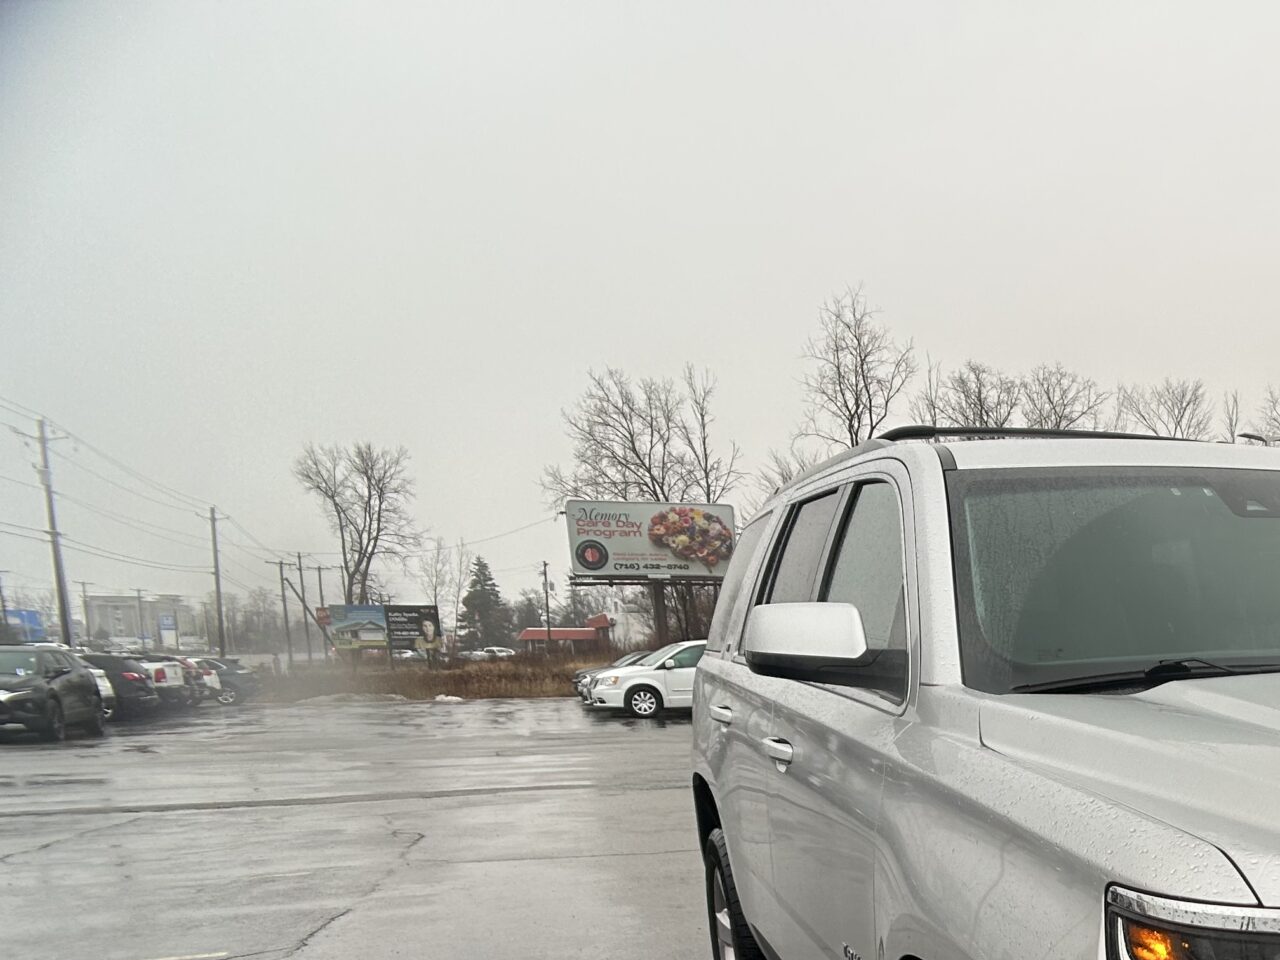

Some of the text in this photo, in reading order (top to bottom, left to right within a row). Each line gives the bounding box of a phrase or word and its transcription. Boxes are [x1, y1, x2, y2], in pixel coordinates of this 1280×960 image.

[573, 507, 630, 521] Memory
[575, 519, 643, 530] Care Day
[576, 528, 642, 538] Program
[613, 563, 640, 571] (716)
